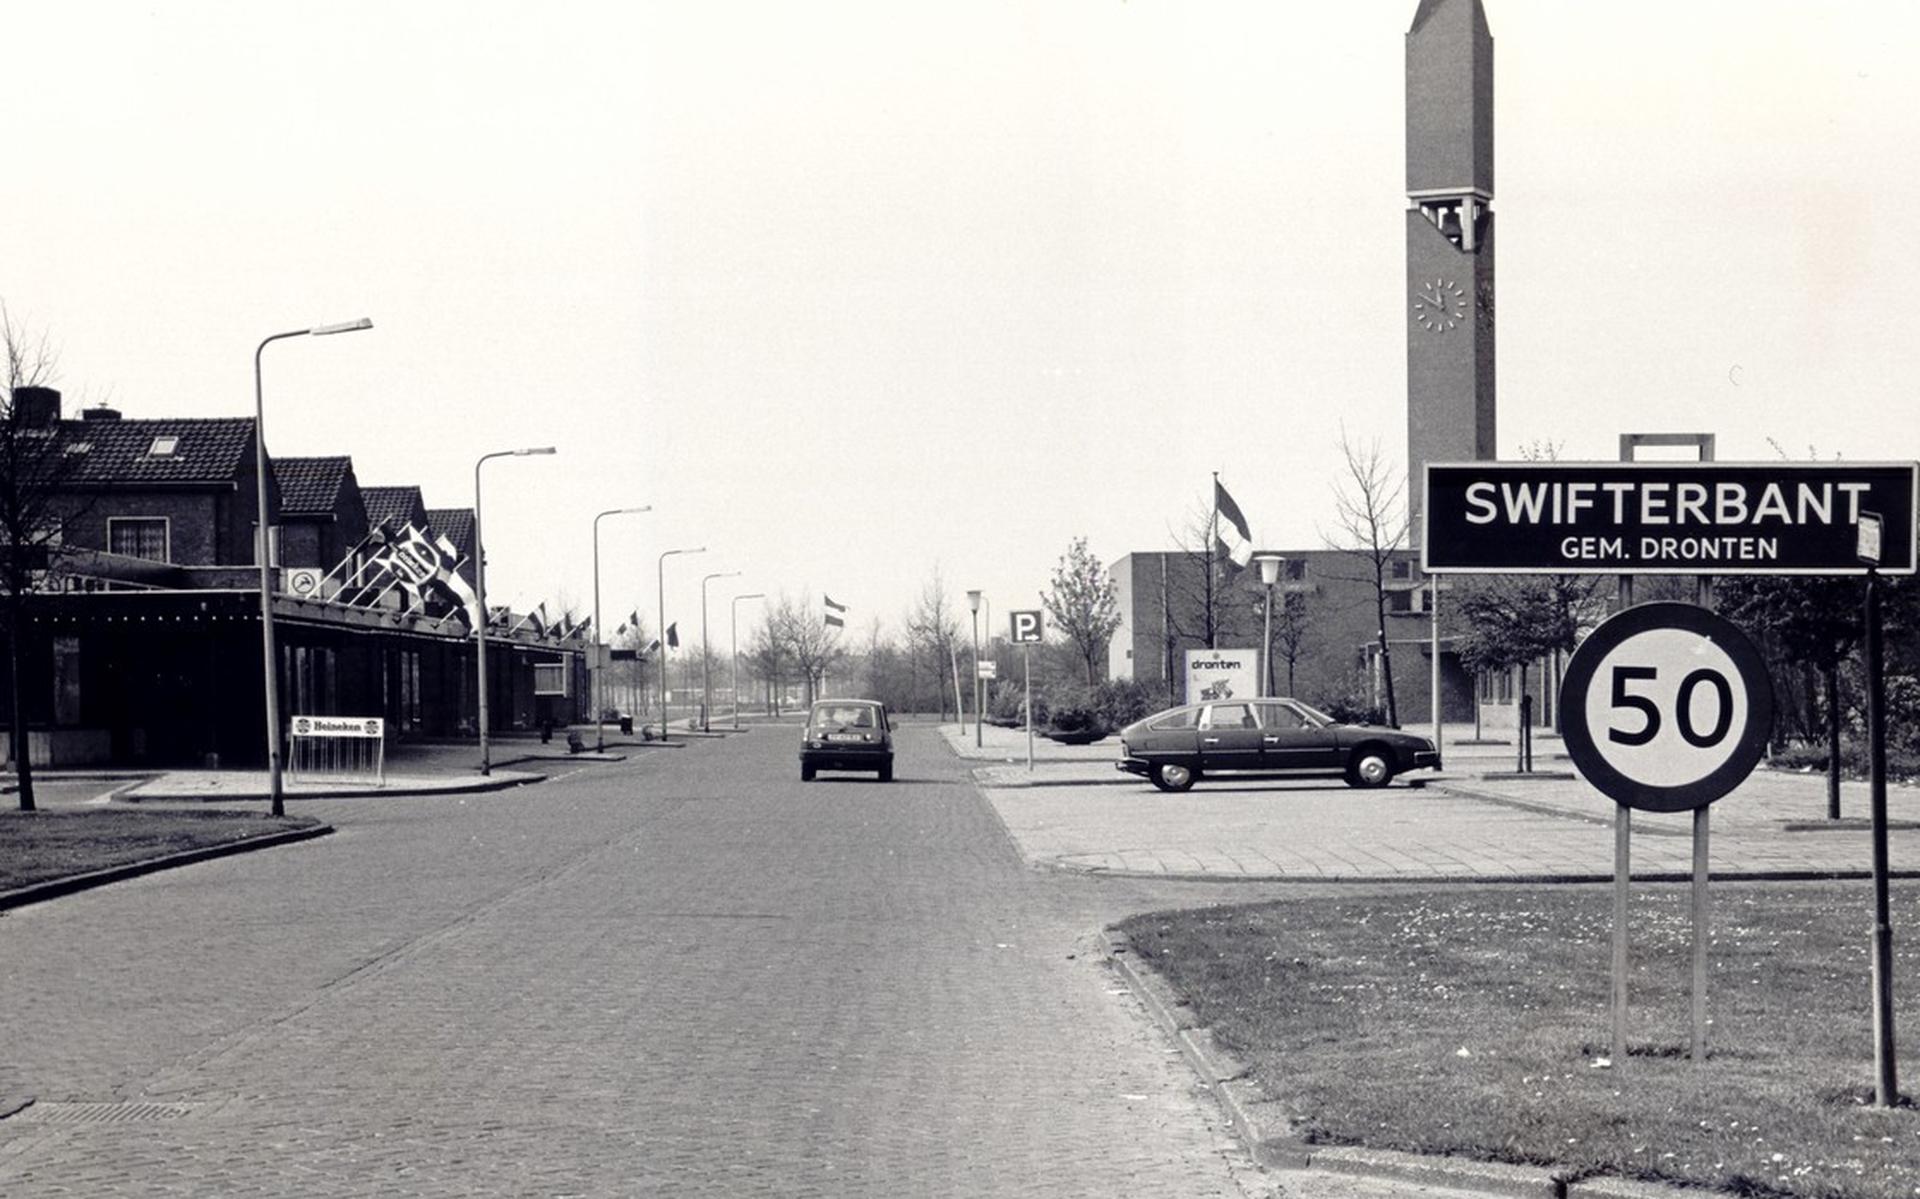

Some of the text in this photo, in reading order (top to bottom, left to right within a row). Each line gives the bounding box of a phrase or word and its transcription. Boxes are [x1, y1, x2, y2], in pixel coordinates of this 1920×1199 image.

[1465, 482, 1871, 524] SWIFTERBANT
[1561, 536, 1777, 559] GEM. DRONTEN
[1015, 613, 1037, 641] P
[1191, 660, 1241, 670] dronten
[1608, 665, 1734, 749] 50
[313, 721, 362, 732] Heineken
